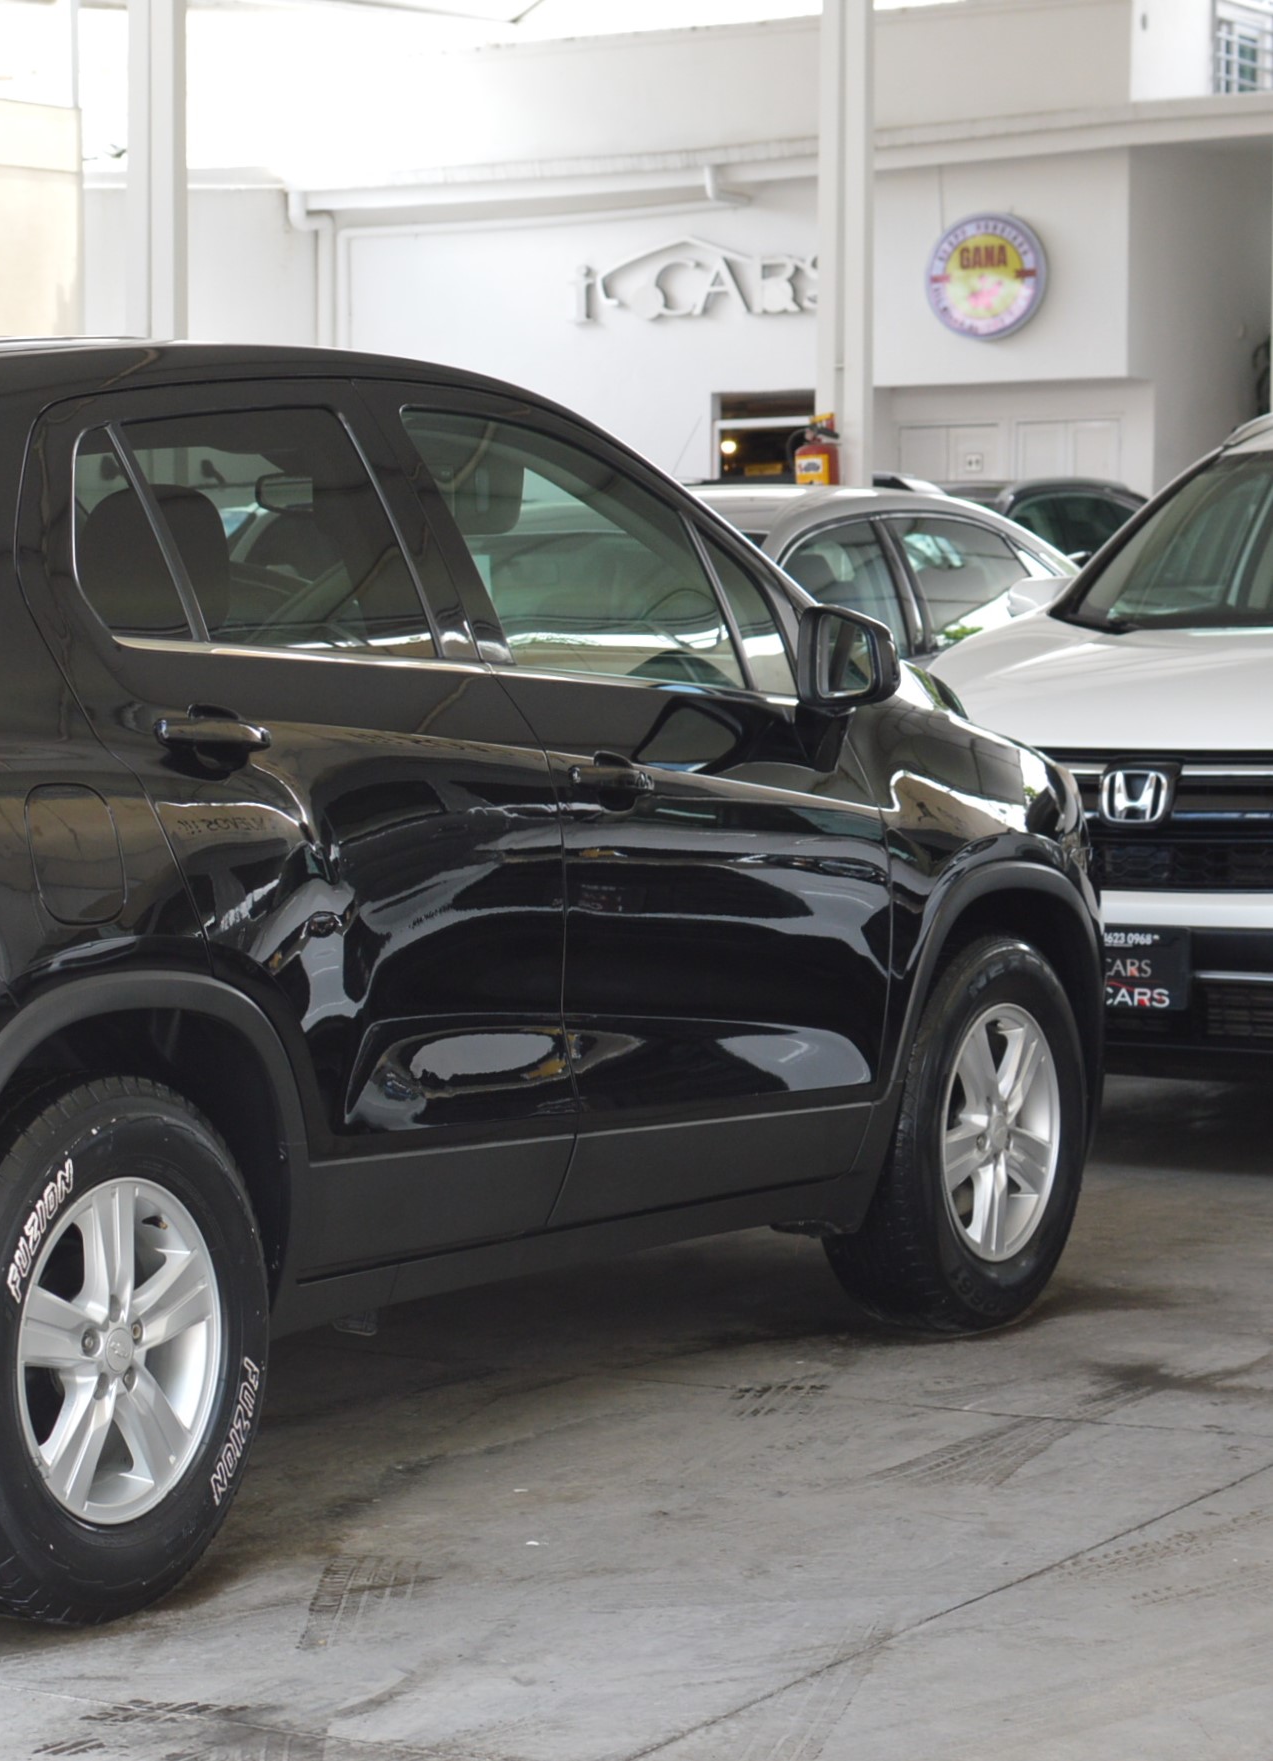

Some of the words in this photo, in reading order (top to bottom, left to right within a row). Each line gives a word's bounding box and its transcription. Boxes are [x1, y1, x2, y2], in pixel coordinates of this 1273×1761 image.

[959, 245, 1008, 270] GANA
[575, 264, 593, 322] i
[1126, 933, 1152, 946] 0968
[7, 1158, 74, 1304] FUZION
[210, 1356, 260, 1506] FUZION
